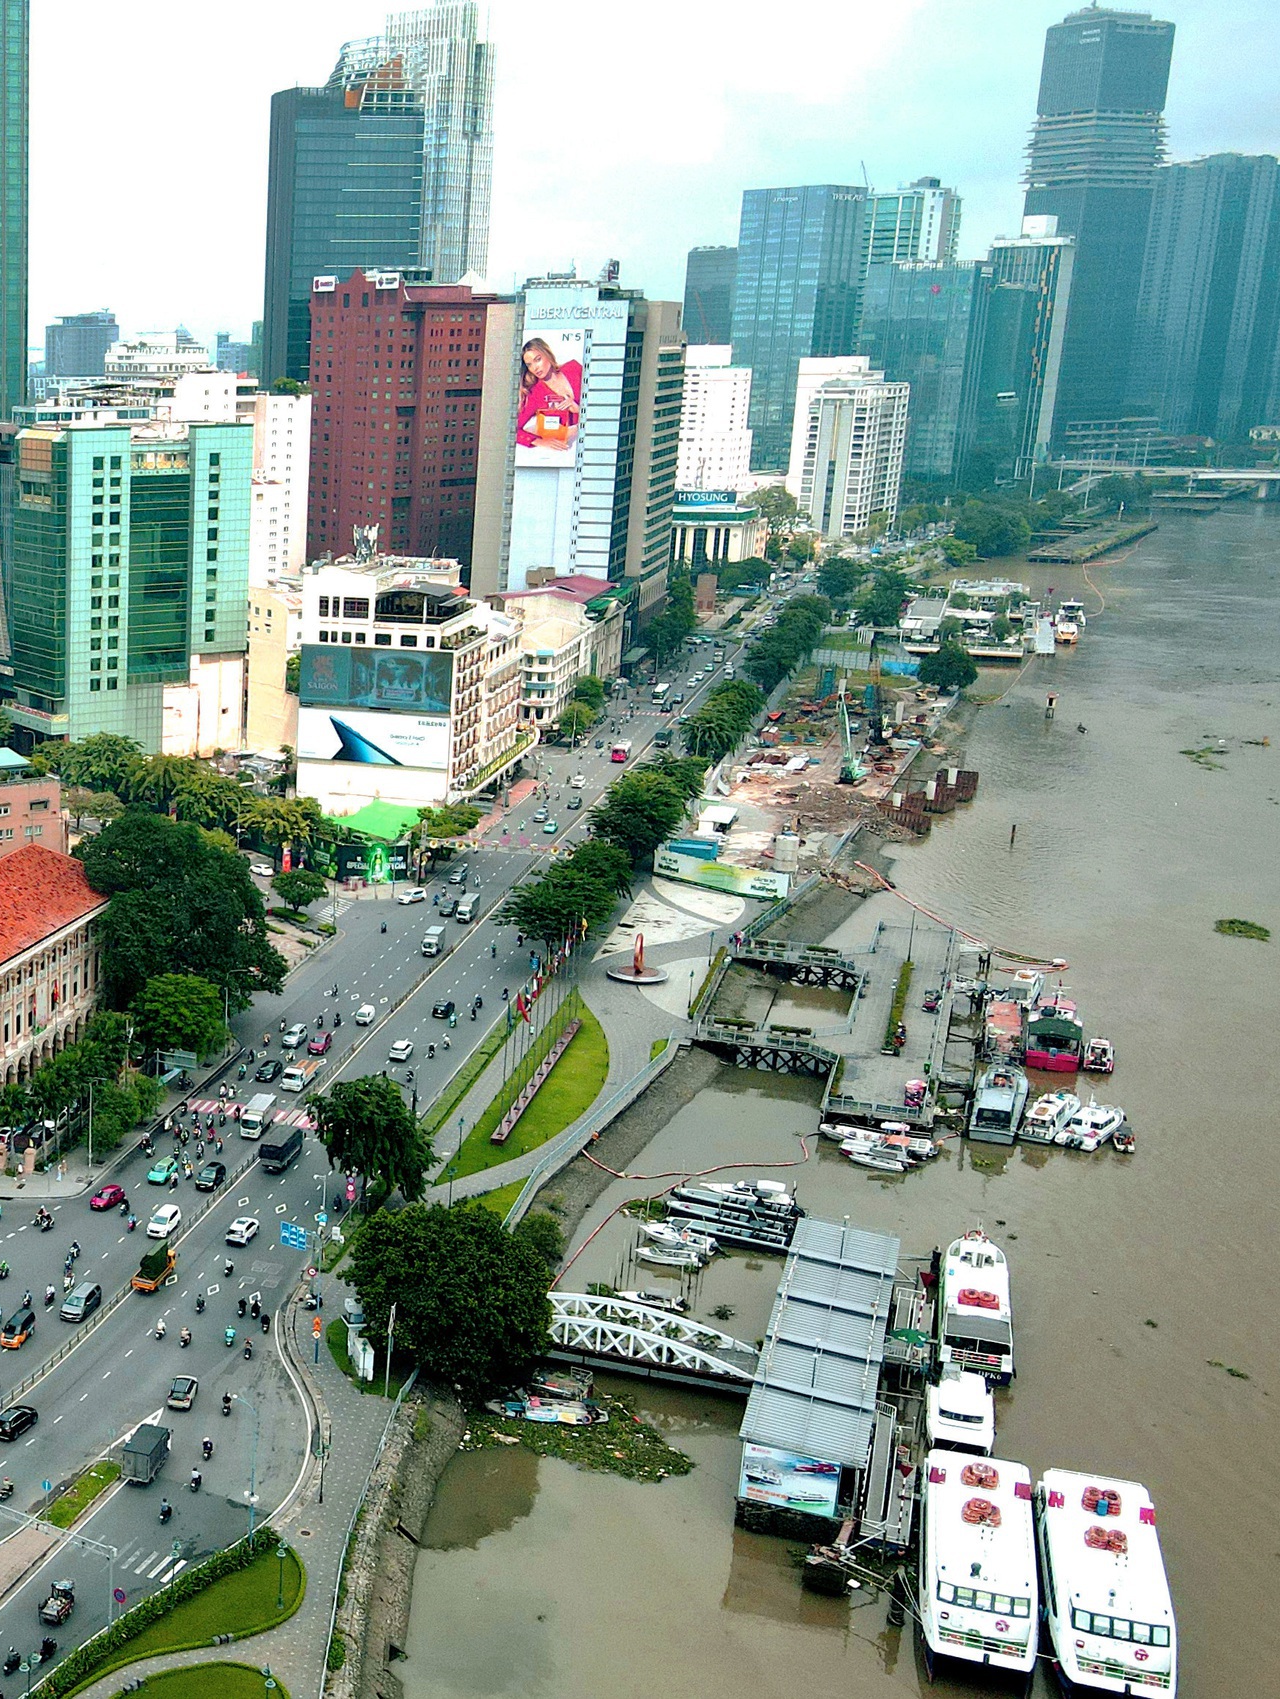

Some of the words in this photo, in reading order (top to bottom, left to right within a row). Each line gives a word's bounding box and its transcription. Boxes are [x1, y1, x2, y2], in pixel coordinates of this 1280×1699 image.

[530, 305, 573, 320] LIBERTY
[573, 305, 623, 319] CENTRAL
[678, 492, 728, 502] HYOSUNG
